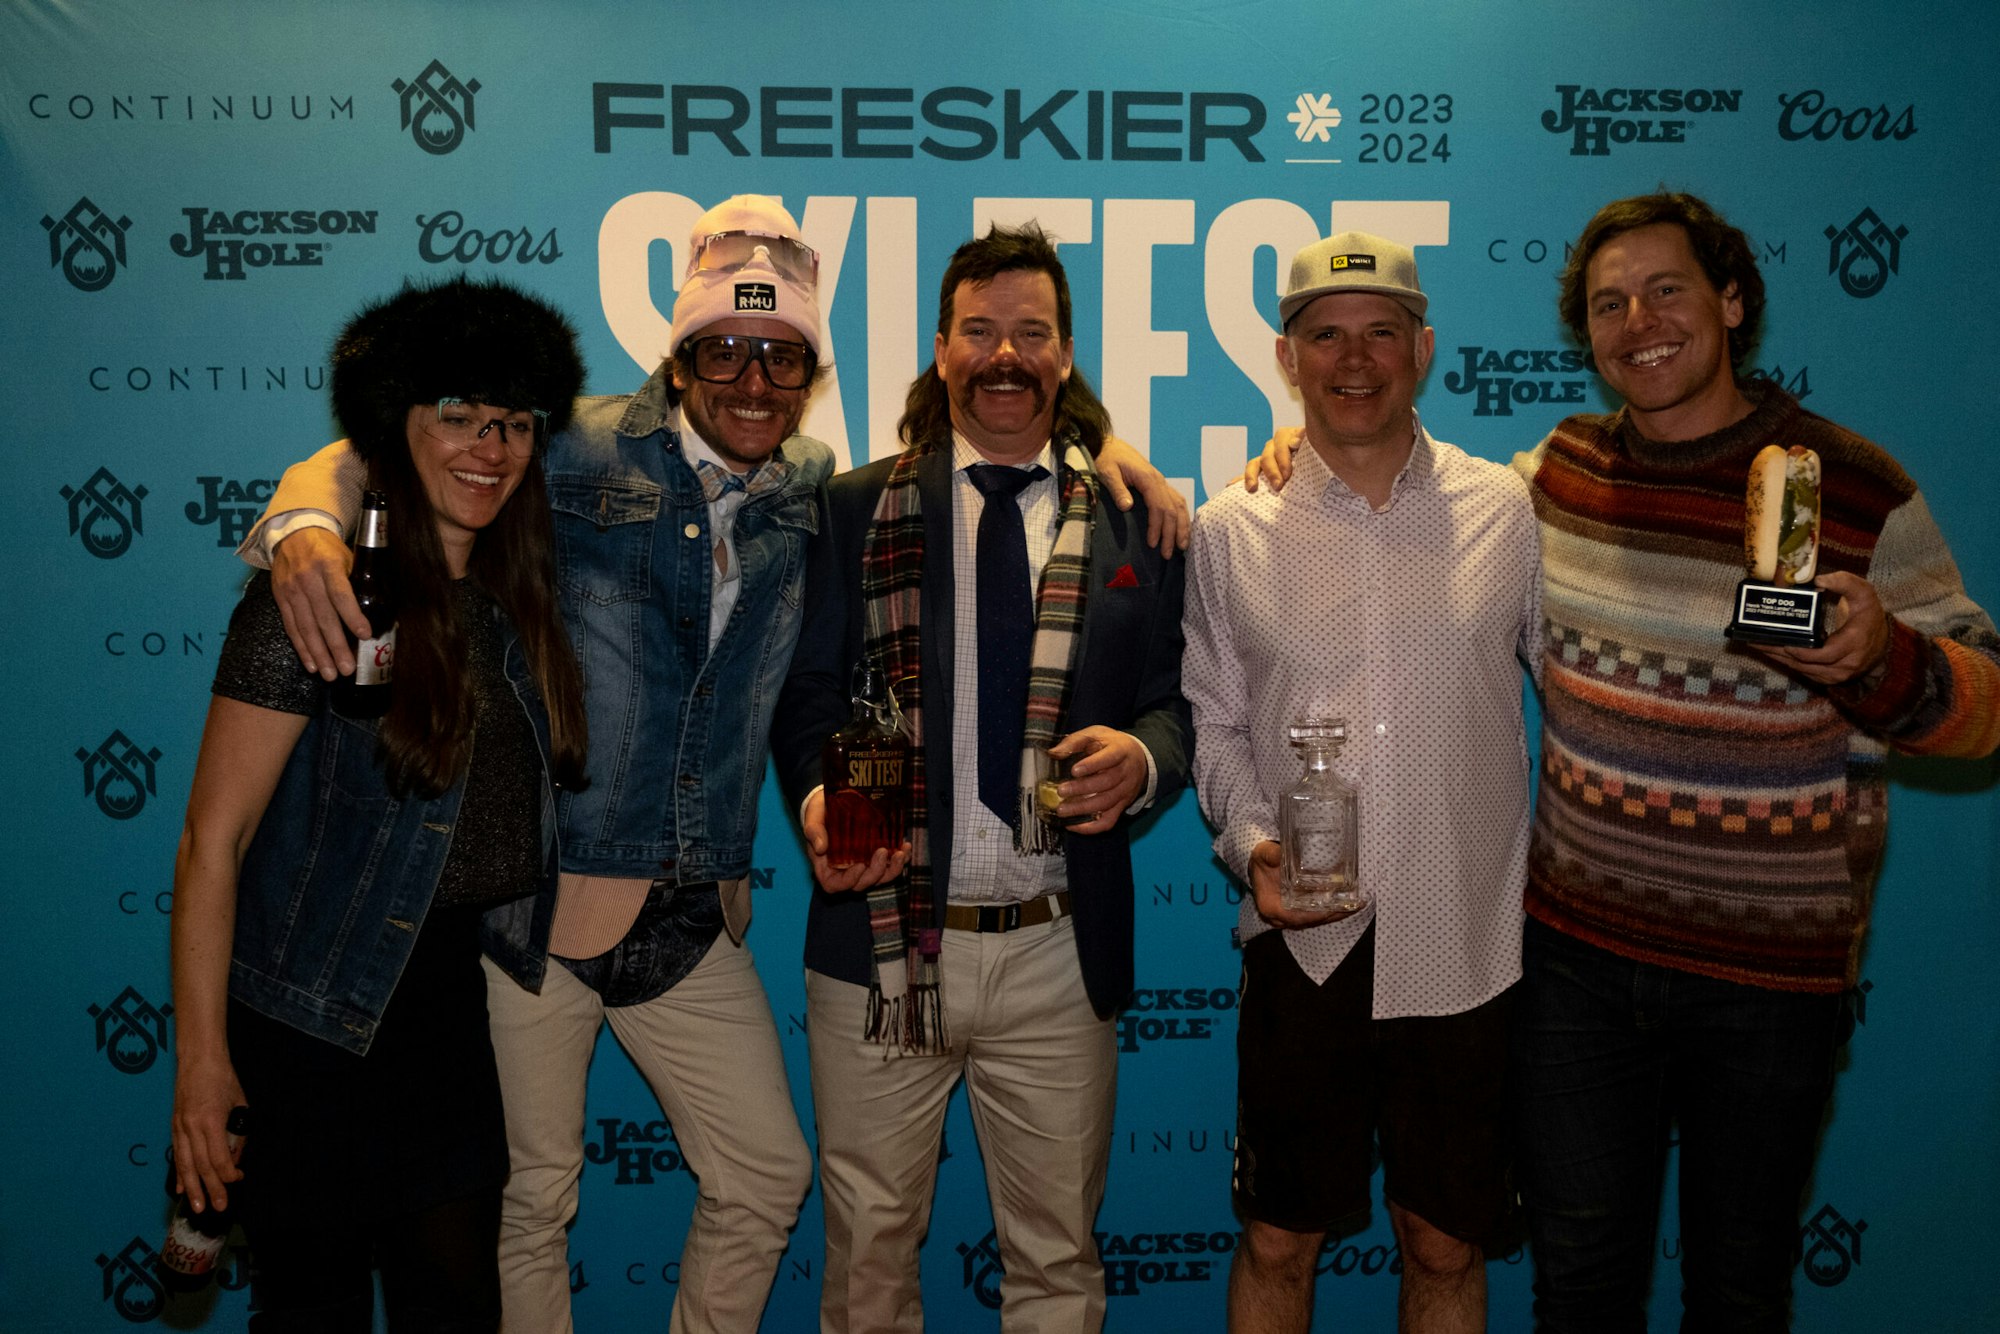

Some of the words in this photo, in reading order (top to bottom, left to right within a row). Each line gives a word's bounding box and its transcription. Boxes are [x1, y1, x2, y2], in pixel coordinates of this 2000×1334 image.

[29, 93, 353, 120] CONTINUUM
[592, 82, 1266, 162] FREESKIER
[1358, 93, 1453, 125] 2023
[1541, 85, 1743, 134] JACKSON
[1777, 89, 1918, 141] Coors
[1358, 132, 1451, 164] 2024
[169, 206, 379, 258] JACKSON
[415, 210, 563, 265] Coors
[89, 366, 323, 391] CONTINU
[973, 197, 1450, 521] ES
[1444, 346, 1600, 395] JACKSO
[1778, 599, 1795, 607] DOG
[849, 760, 873, 787] SKI
[874, 759, 904, 787] TEST
